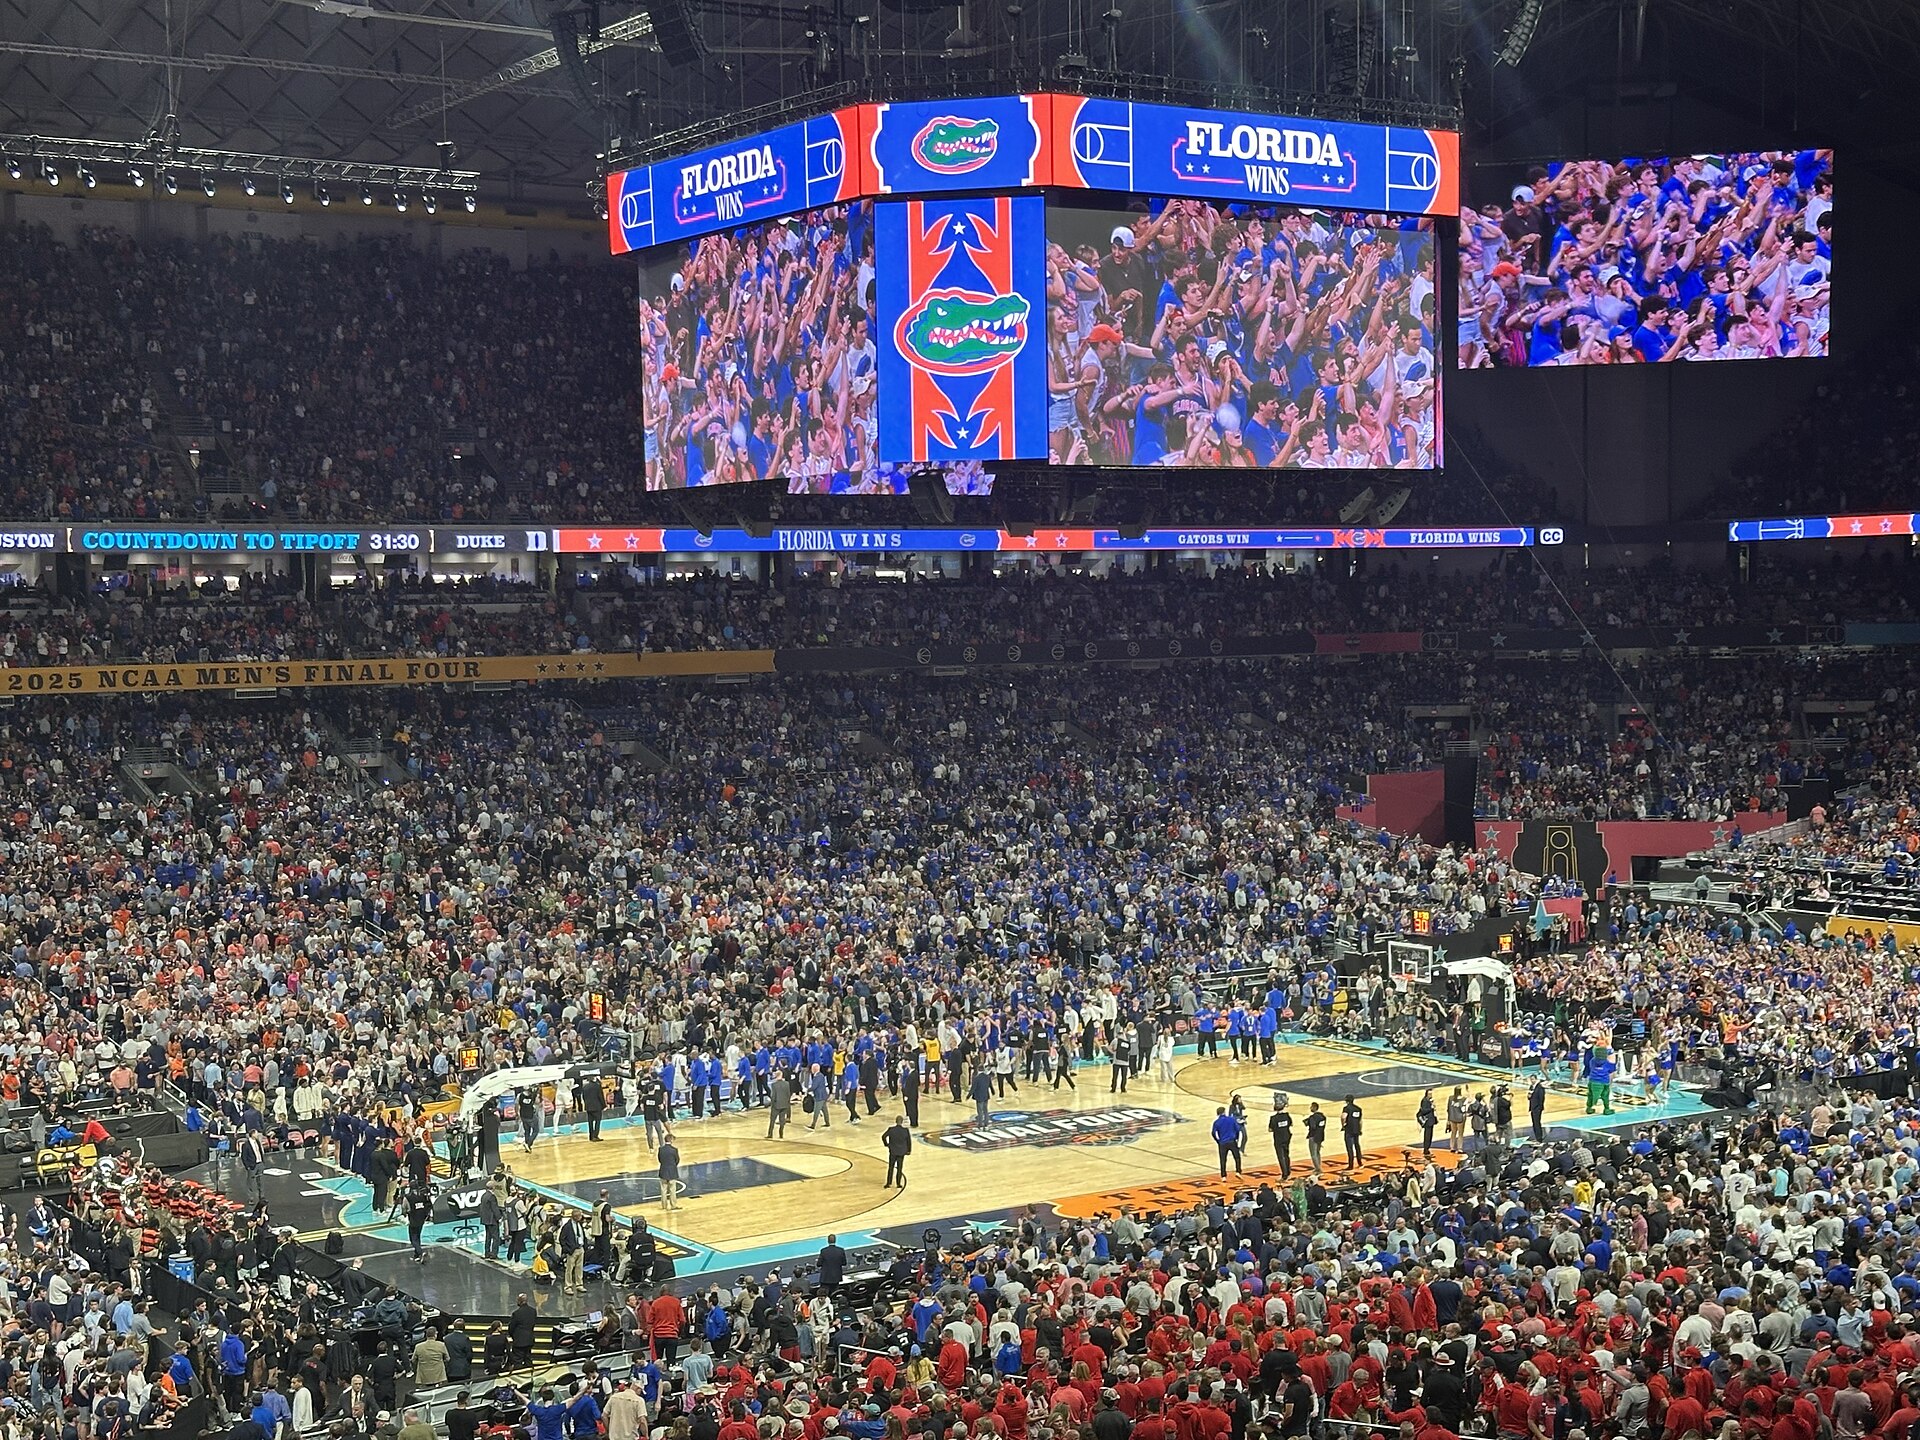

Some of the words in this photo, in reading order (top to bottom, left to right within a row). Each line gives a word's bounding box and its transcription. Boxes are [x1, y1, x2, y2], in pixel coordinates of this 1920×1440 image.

[1185, 120, 1344, 167] FLORIDA
[680, 144, 777, 200] FLORIDA
[1243, 164, 1290, 196] WINS
[714, 190, 744, 222] WINS
[0, 533, 55, 548] STON
[82, 532, 238, 550] COUNTDOWN
[243, 533, 275, 550] TO
[280, 533, 360, 551] TIPOFF
[369, 533, 420, 550] 31:30
[456, 535, 506, 549] DUKE
[778, 530, 835, 551] FLORIDA
[840, 533, 903, 547] WINS
[1178, 533, 1226, 546] GATORS
[1229, 533, 1250, 545] WIN
[1410, 531, 1464, 545] FLORIDA
[1468, 531, 1501, 544] WINS
[1542, 530, 1562, 543] CC
[8, 672, 83, 691] 2025
[98, 668, 183, 688] NCAA
[196, 665, 291, 685] MEN'S
[304, 664, 394, 682] FINAL
[406, 661, 482, 680] FOUR
[463, 1057, 477, 1067] 30
[940, 1120, 1055, 1147] FINAL
[1052, 1107, 1162, 1131] FOUR
[1098, 1179, 1220, 1200] THE
[1242, 1153, 1388, 1179] ROAD
[1734, 1181, 1742, 1193] 2
